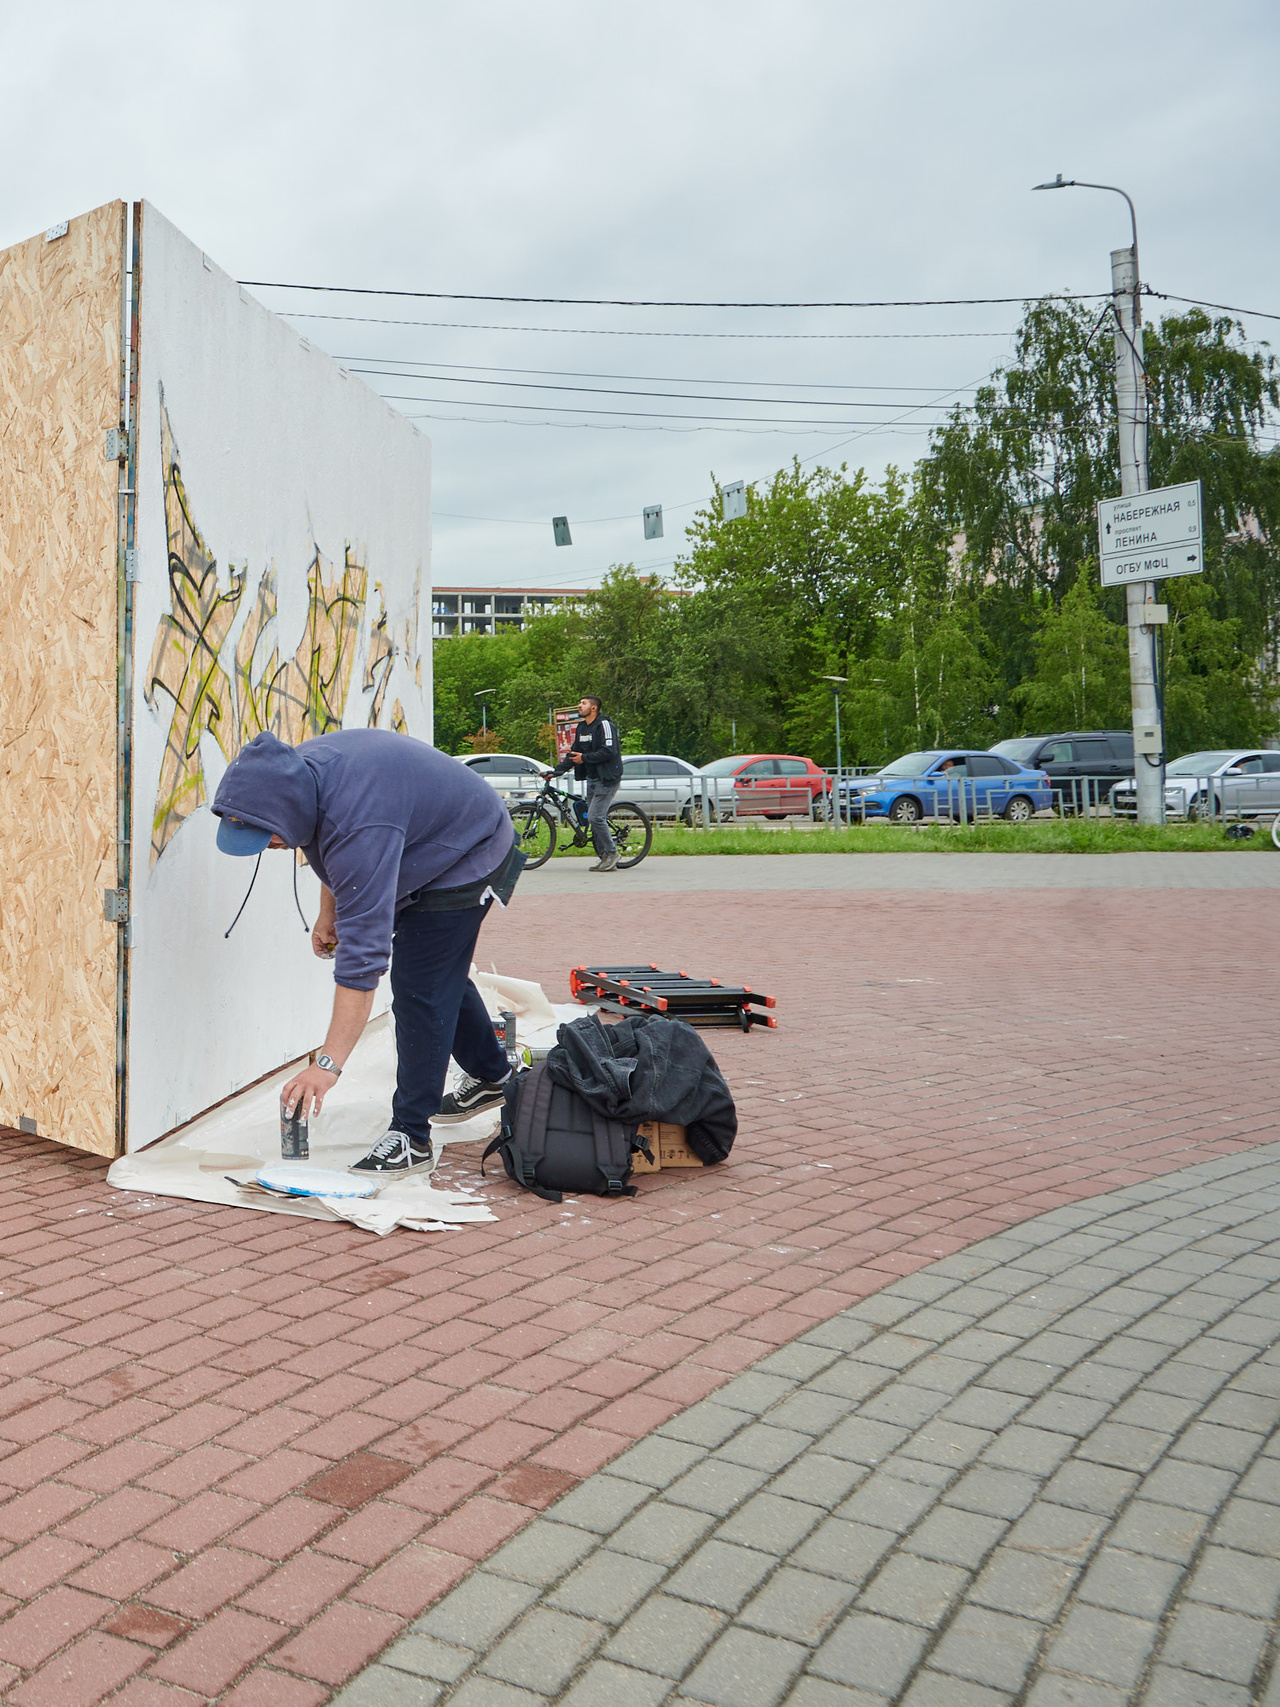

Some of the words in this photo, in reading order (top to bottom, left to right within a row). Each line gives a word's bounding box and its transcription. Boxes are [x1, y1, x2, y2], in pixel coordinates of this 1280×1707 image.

[1113, 502, 1131, 511] улица
[1187, 499, 1196, 507] 0,5
[1113, 501, 1180, 523] НАБЕРЕЖНАЯ
[1115, 525, 1142, 535] проспект
[1188, 525, 1197, 533] 0,9
[1115, 532, 1157, 548] ЛЕНИНА
[1116, 561, 1141, 575] ОГБУ
[1144, 557, 1168, 570] МФЦ
